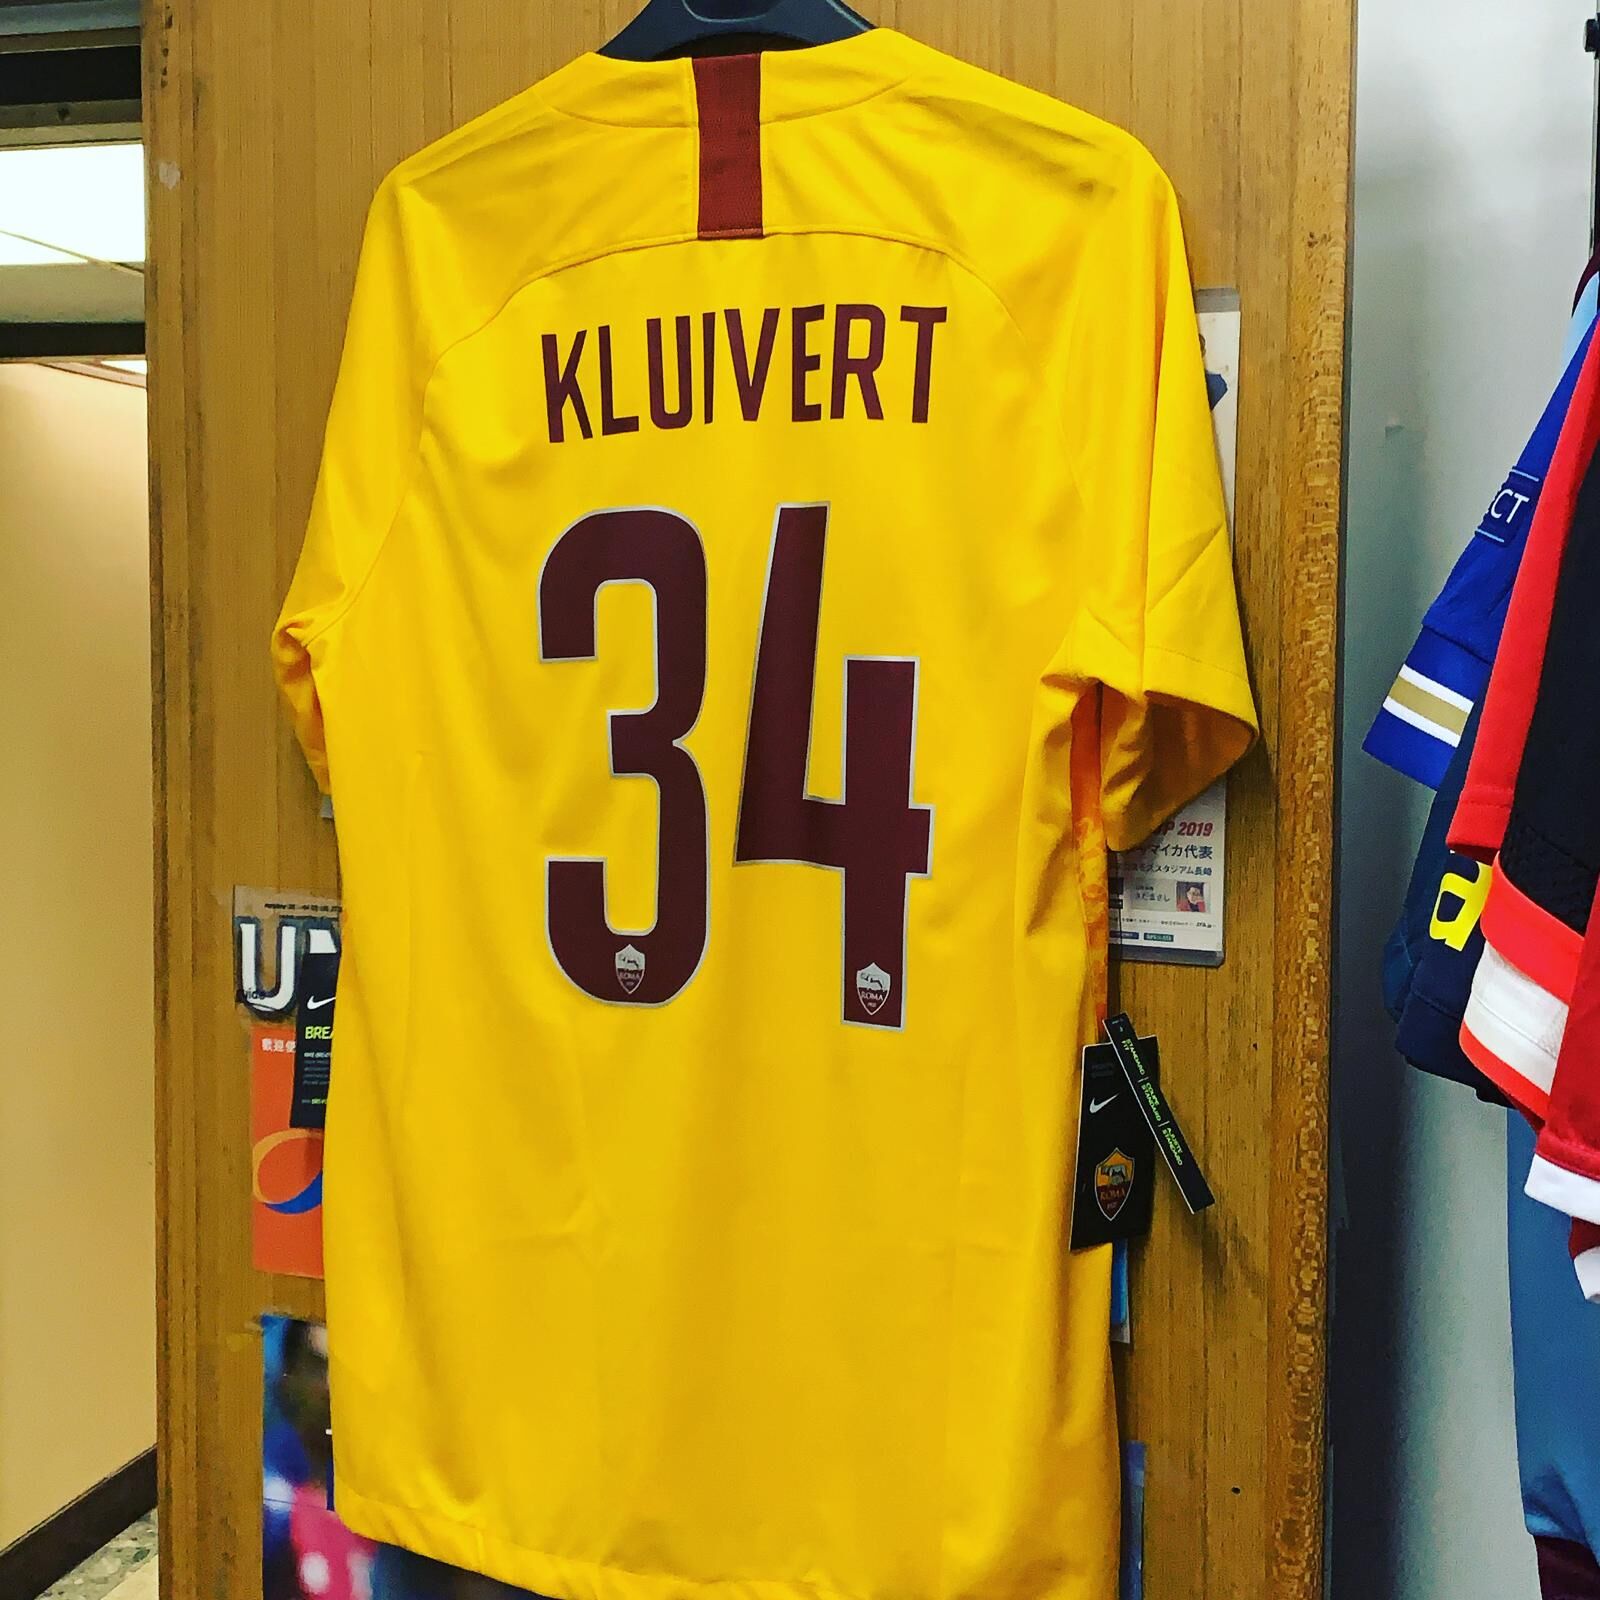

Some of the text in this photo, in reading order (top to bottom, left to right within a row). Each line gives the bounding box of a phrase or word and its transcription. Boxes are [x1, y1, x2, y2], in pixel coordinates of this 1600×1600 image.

[541, 304, 947, 443] KLUIVERT
[537, 502, 935, 1031] 34
[1177, 821, 1213, 837] 2019
[861, 990, 884, 1001] ROMA
[1126, 1038, 1145, 1076] STANDARD
[1141, 1084, 1161, 1122] STANDARD
[1162, 1129, 1183, 1166] STANDARD
